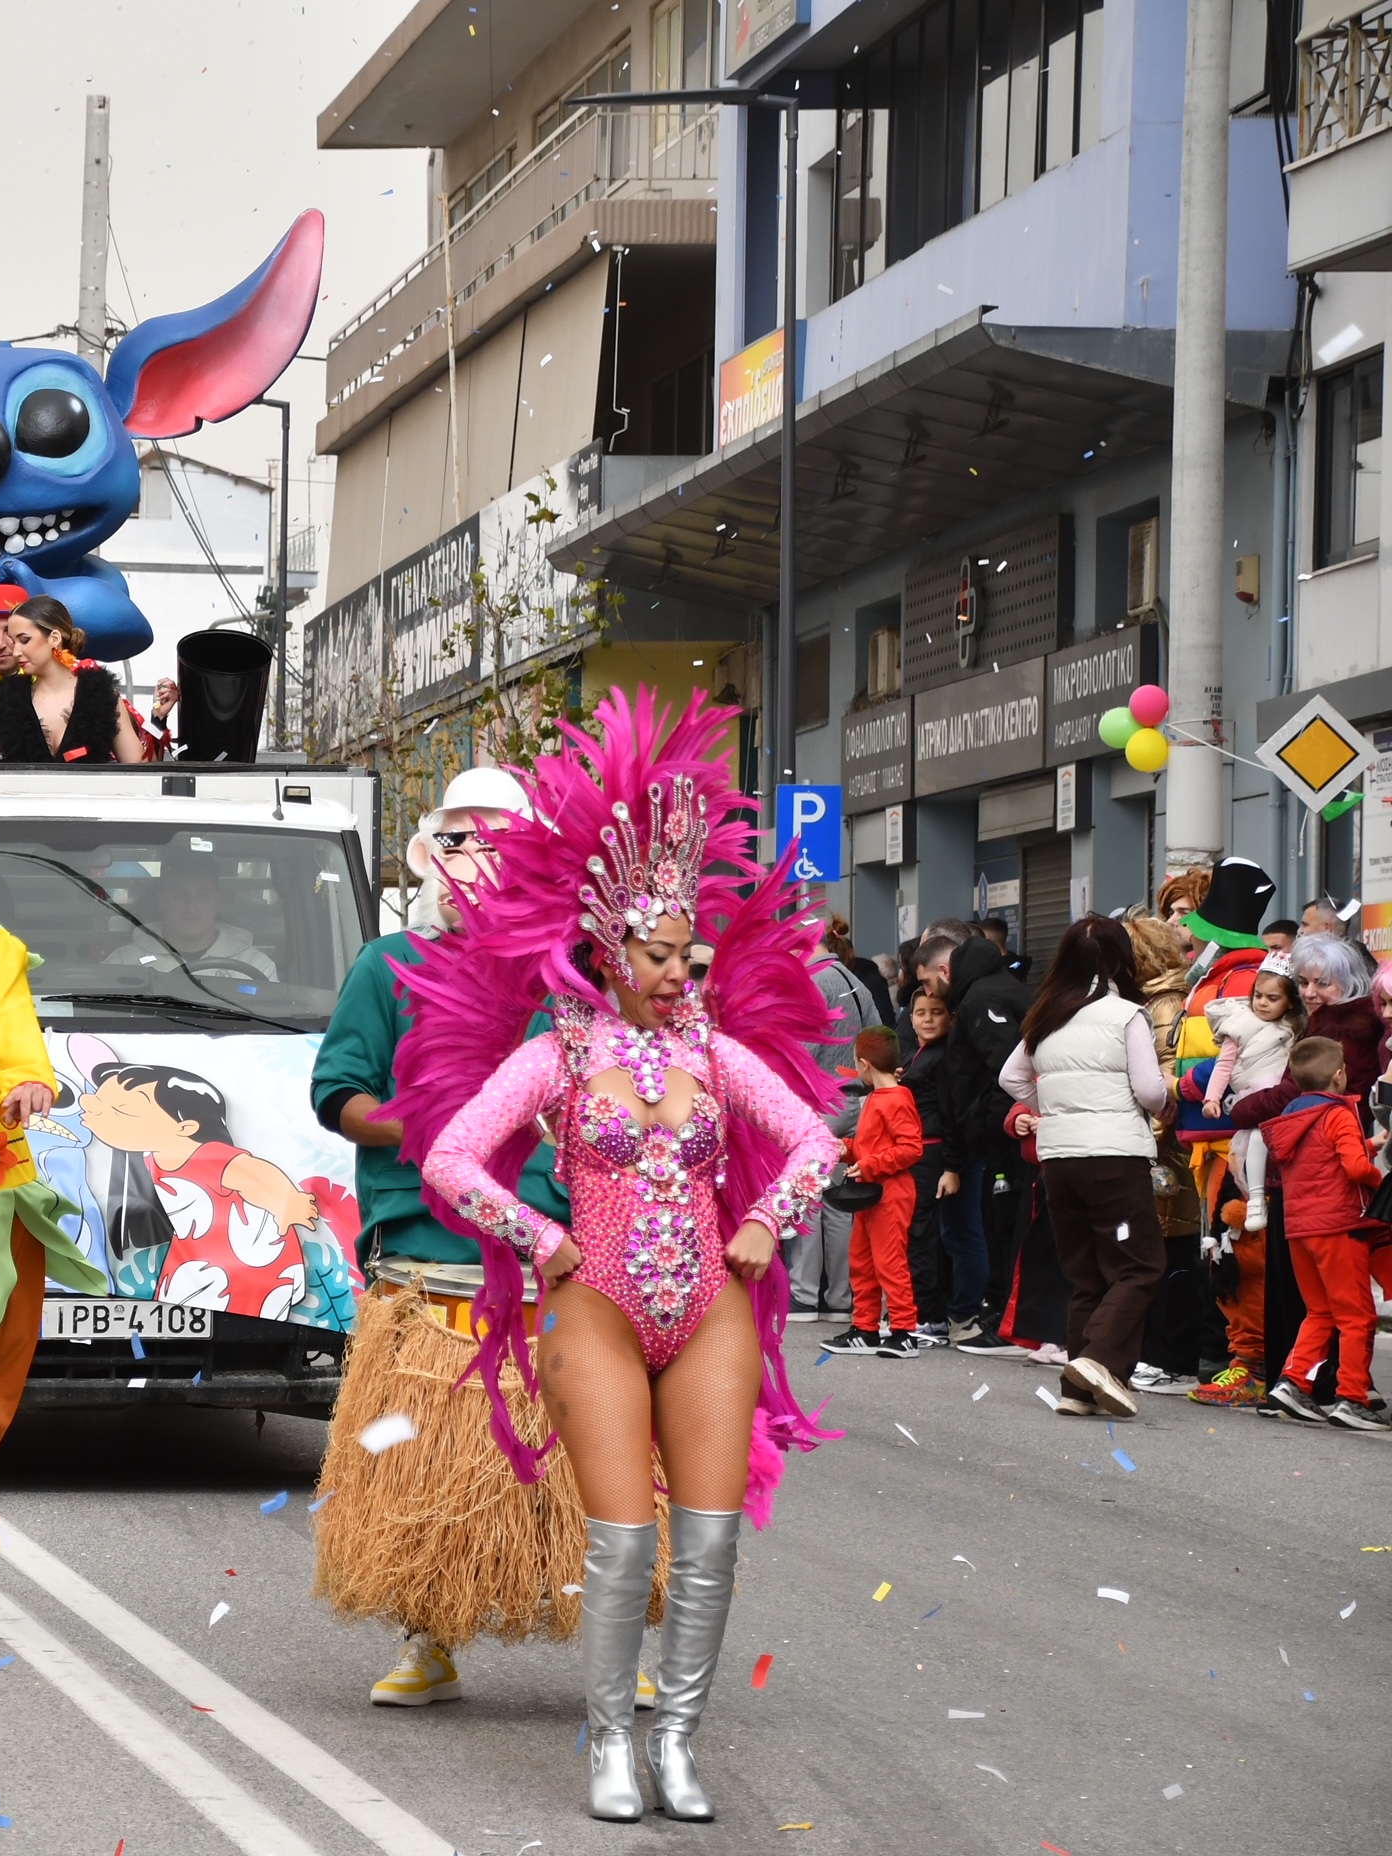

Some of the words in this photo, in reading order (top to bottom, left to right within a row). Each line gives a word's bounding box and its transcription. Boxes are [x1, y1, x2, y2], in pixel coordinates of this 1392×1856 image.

[720, 368, 783, 446] εκπαίδευσ
[391, 532, 471, 620] ΓΥΜΝΑΣΤΗΡΙΟ
[1054, 644, 1133, 705] ΜΙΚΡΟΒΙΟΛΟΓΙΚΟ
[846, 711, 906, 761] ΟΦΘΑΛΜΟΛΟΓΙΚΟ
[917, 718, 948, 760] ΙΑΤΡΙΚΟ
[949, 704, 1003, 754] ΔΙΑΓΝΩΣΤΙΚΟ
[1004, 695, 1038, 742] ΚΕΝΤΡΟ
[793, 792, 826, 839] P
[58, 1304, 206, 1334] IPB-4108
